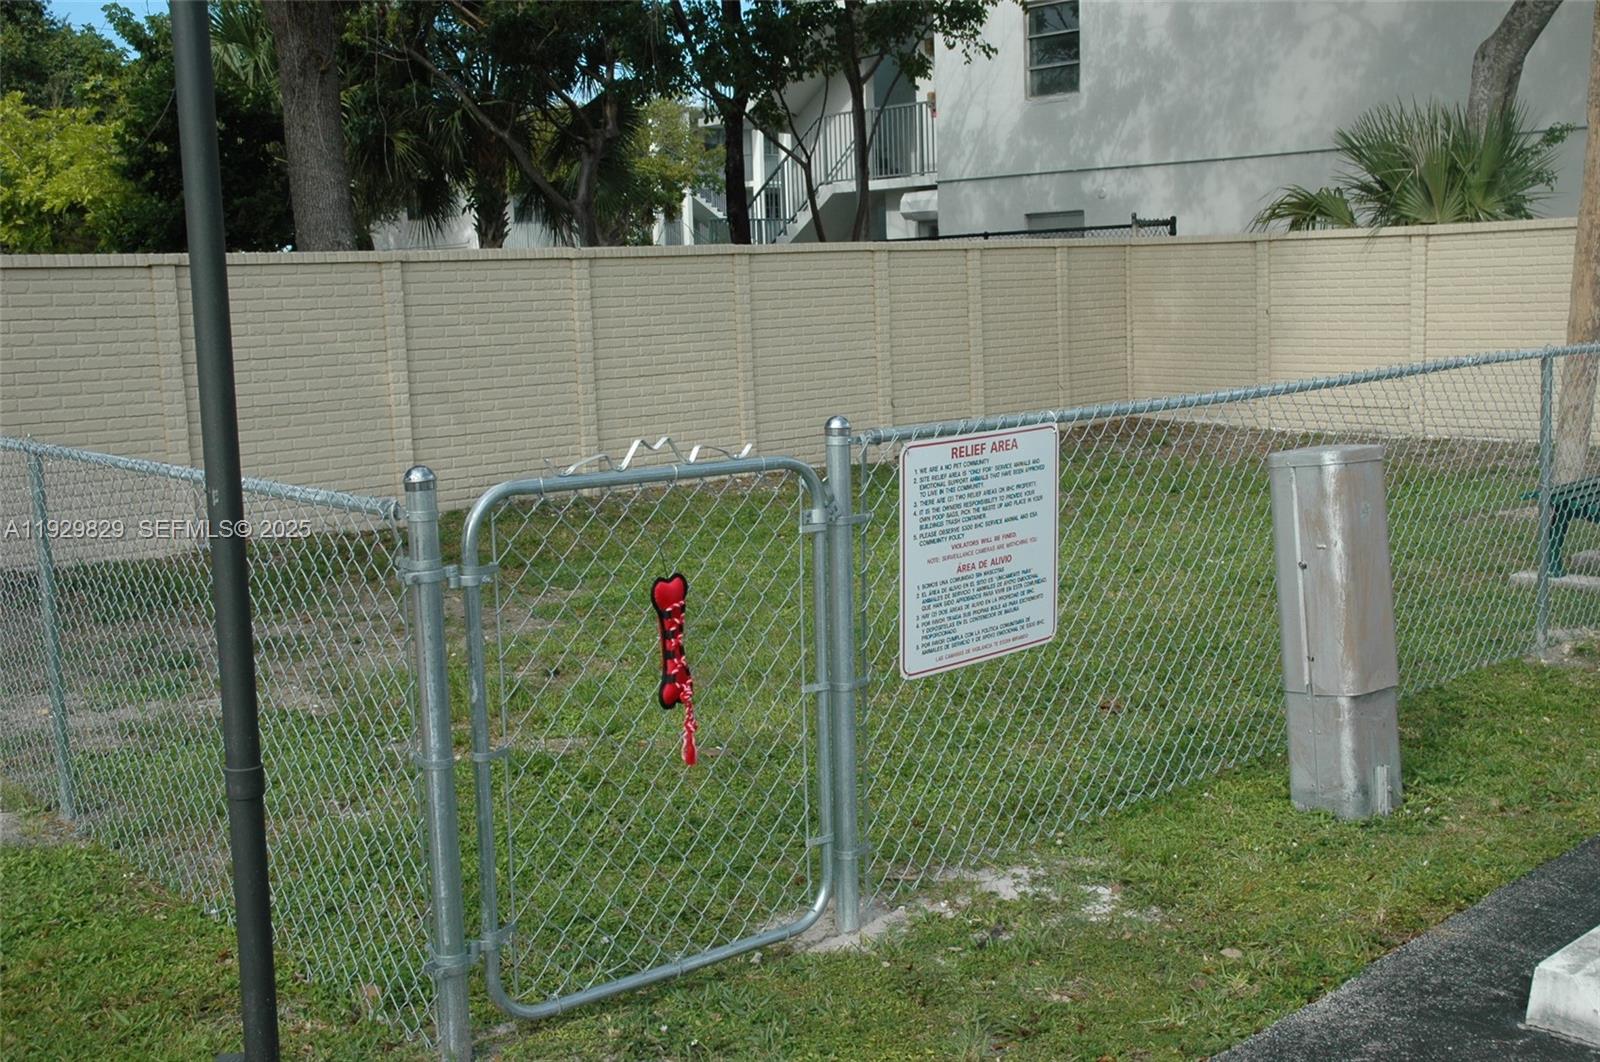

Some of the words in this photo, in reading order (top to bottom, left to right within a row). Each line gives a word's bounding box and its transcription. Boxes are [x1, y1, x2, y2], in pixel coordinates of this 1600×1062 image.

[951, 443, 986, 459] RELIEF
[991, 438, 1018, 453] AREA
[932, 473, 947, 481] RELIEF
[919, 498, 934, 507] THERE
[919, 530, 937, 540] PLEASE
[957, 562, 976, 573] ÁREA
[979, 559, 988, 569] DE
[991, 554, 1012, 566] ALIVIO
